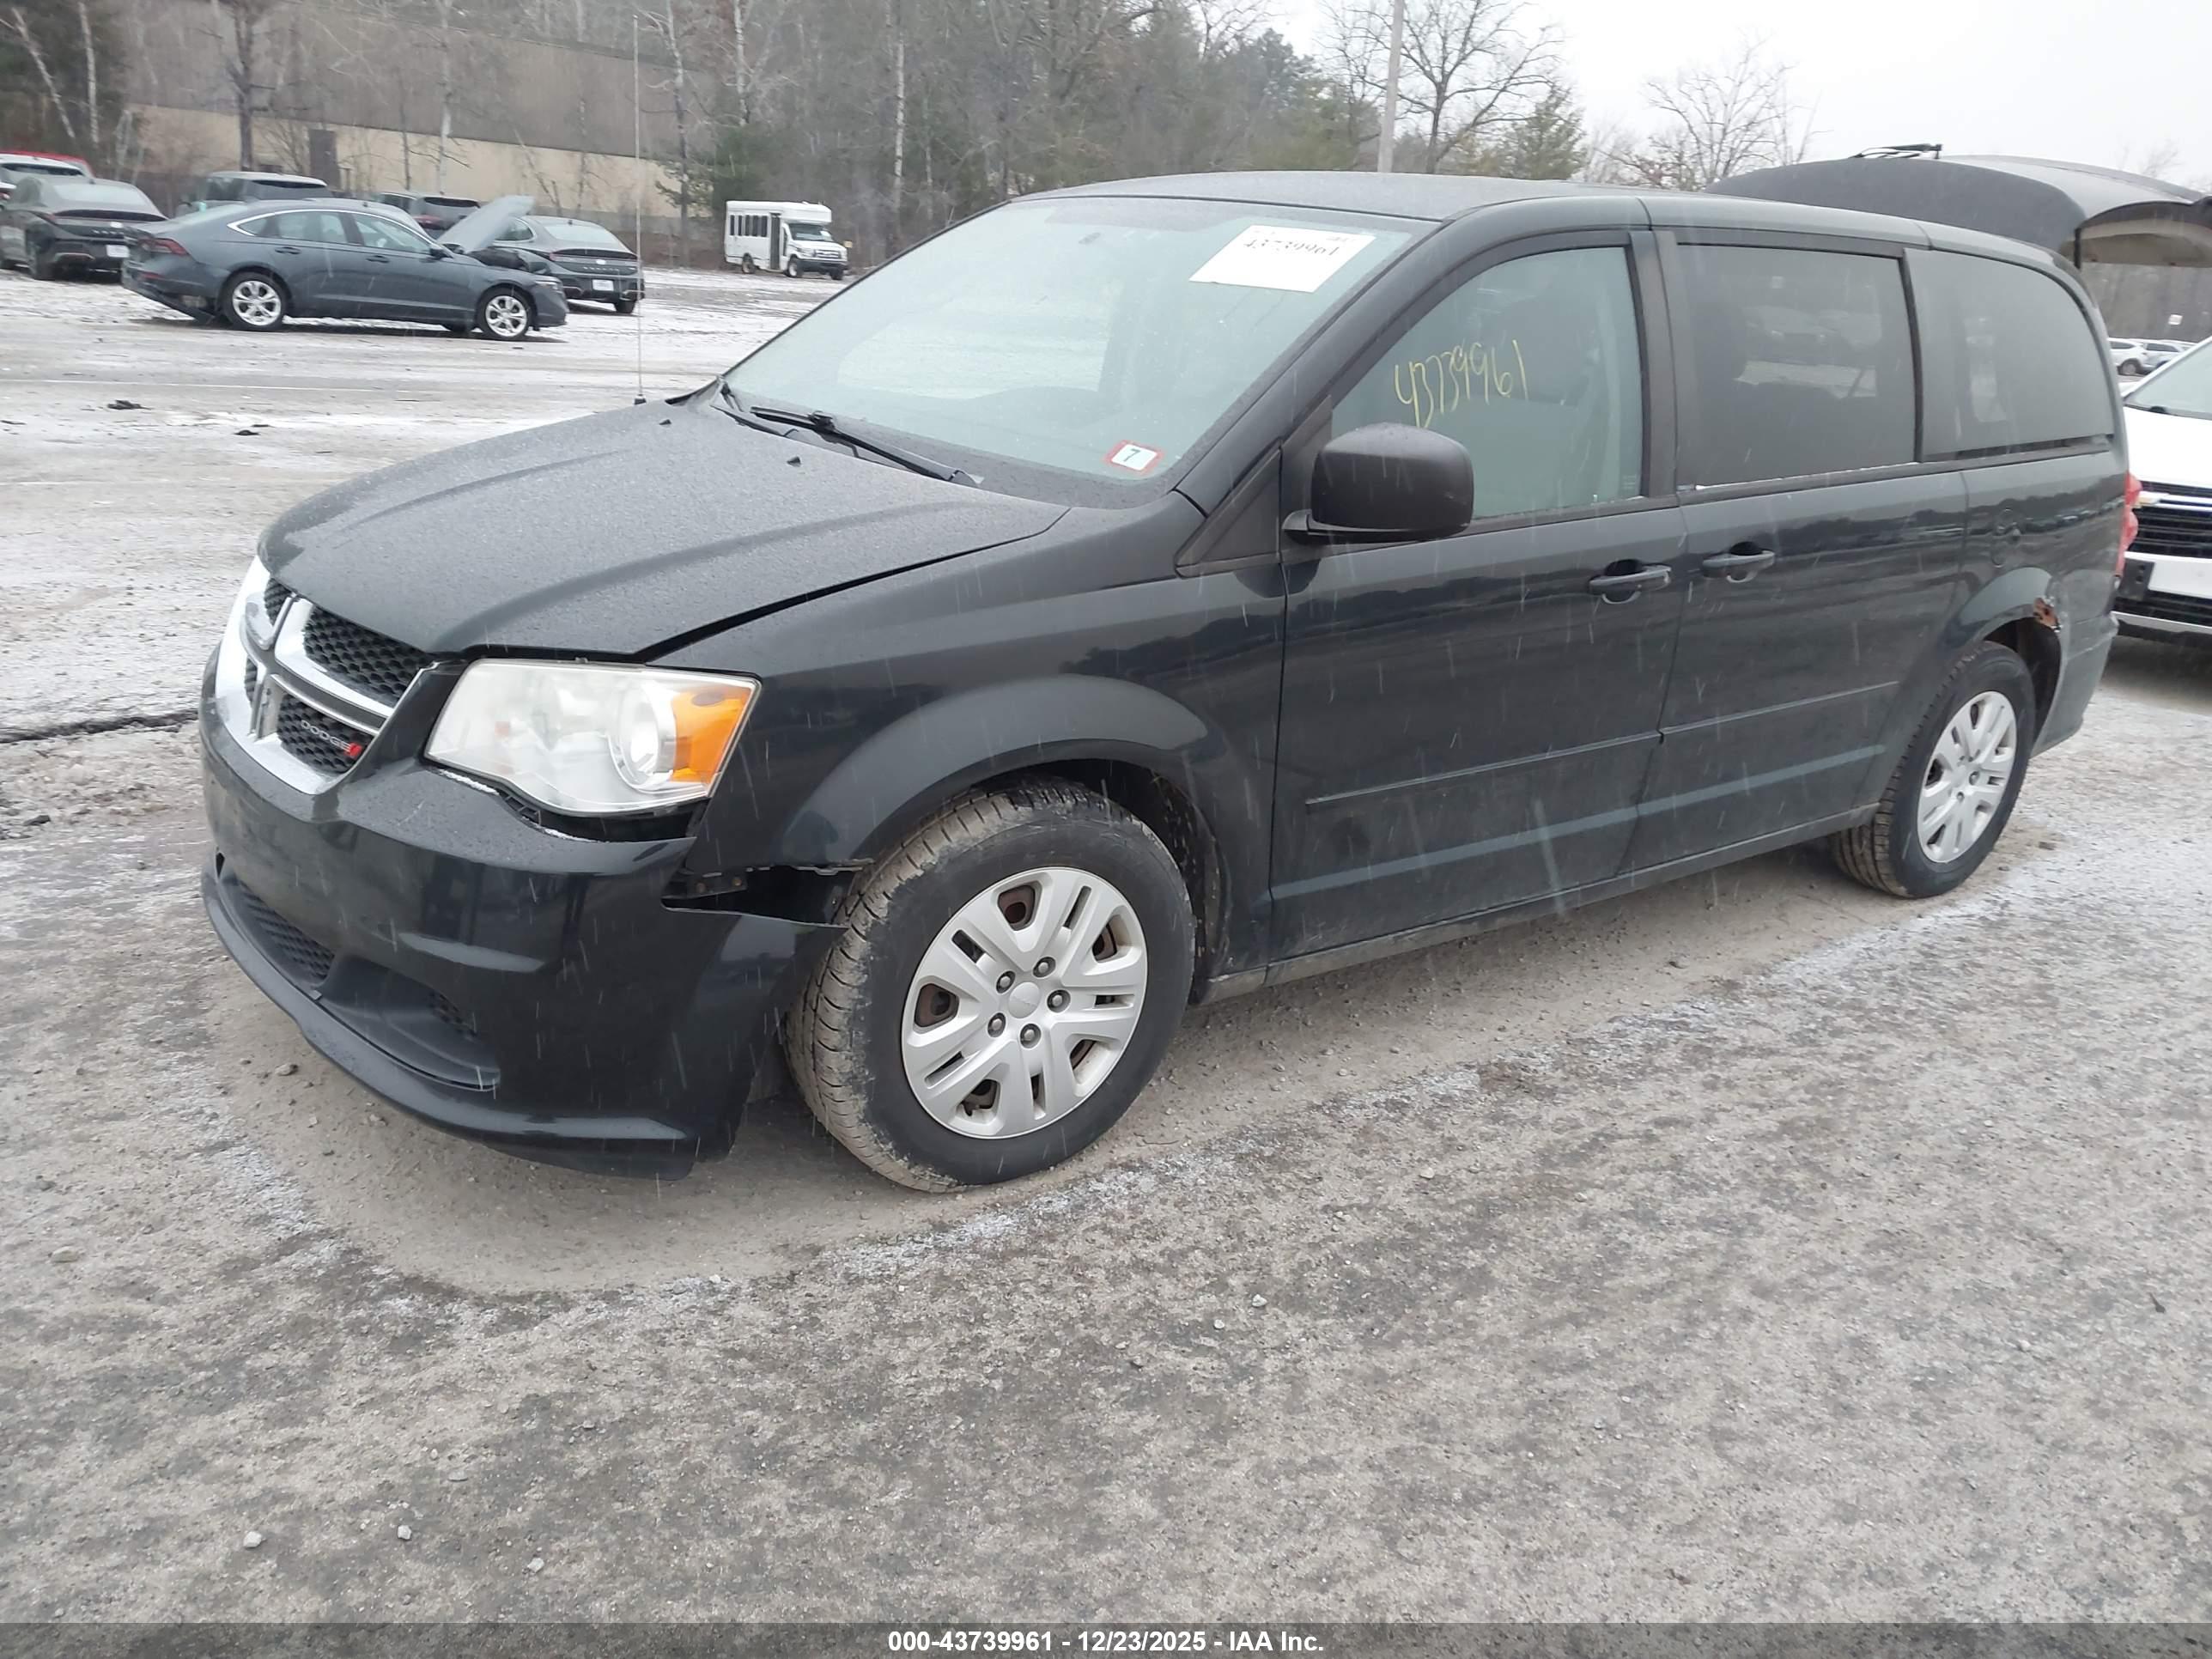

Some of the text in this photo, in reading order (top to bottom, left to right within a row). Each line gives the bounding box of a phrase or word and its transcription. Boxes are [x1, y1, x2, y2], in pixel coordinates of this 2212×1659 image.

[1395, 338, 1529, 428] 43739961
[1123, 448, 1141, 463] 7
[301, 720, 351, 754] DODGE
